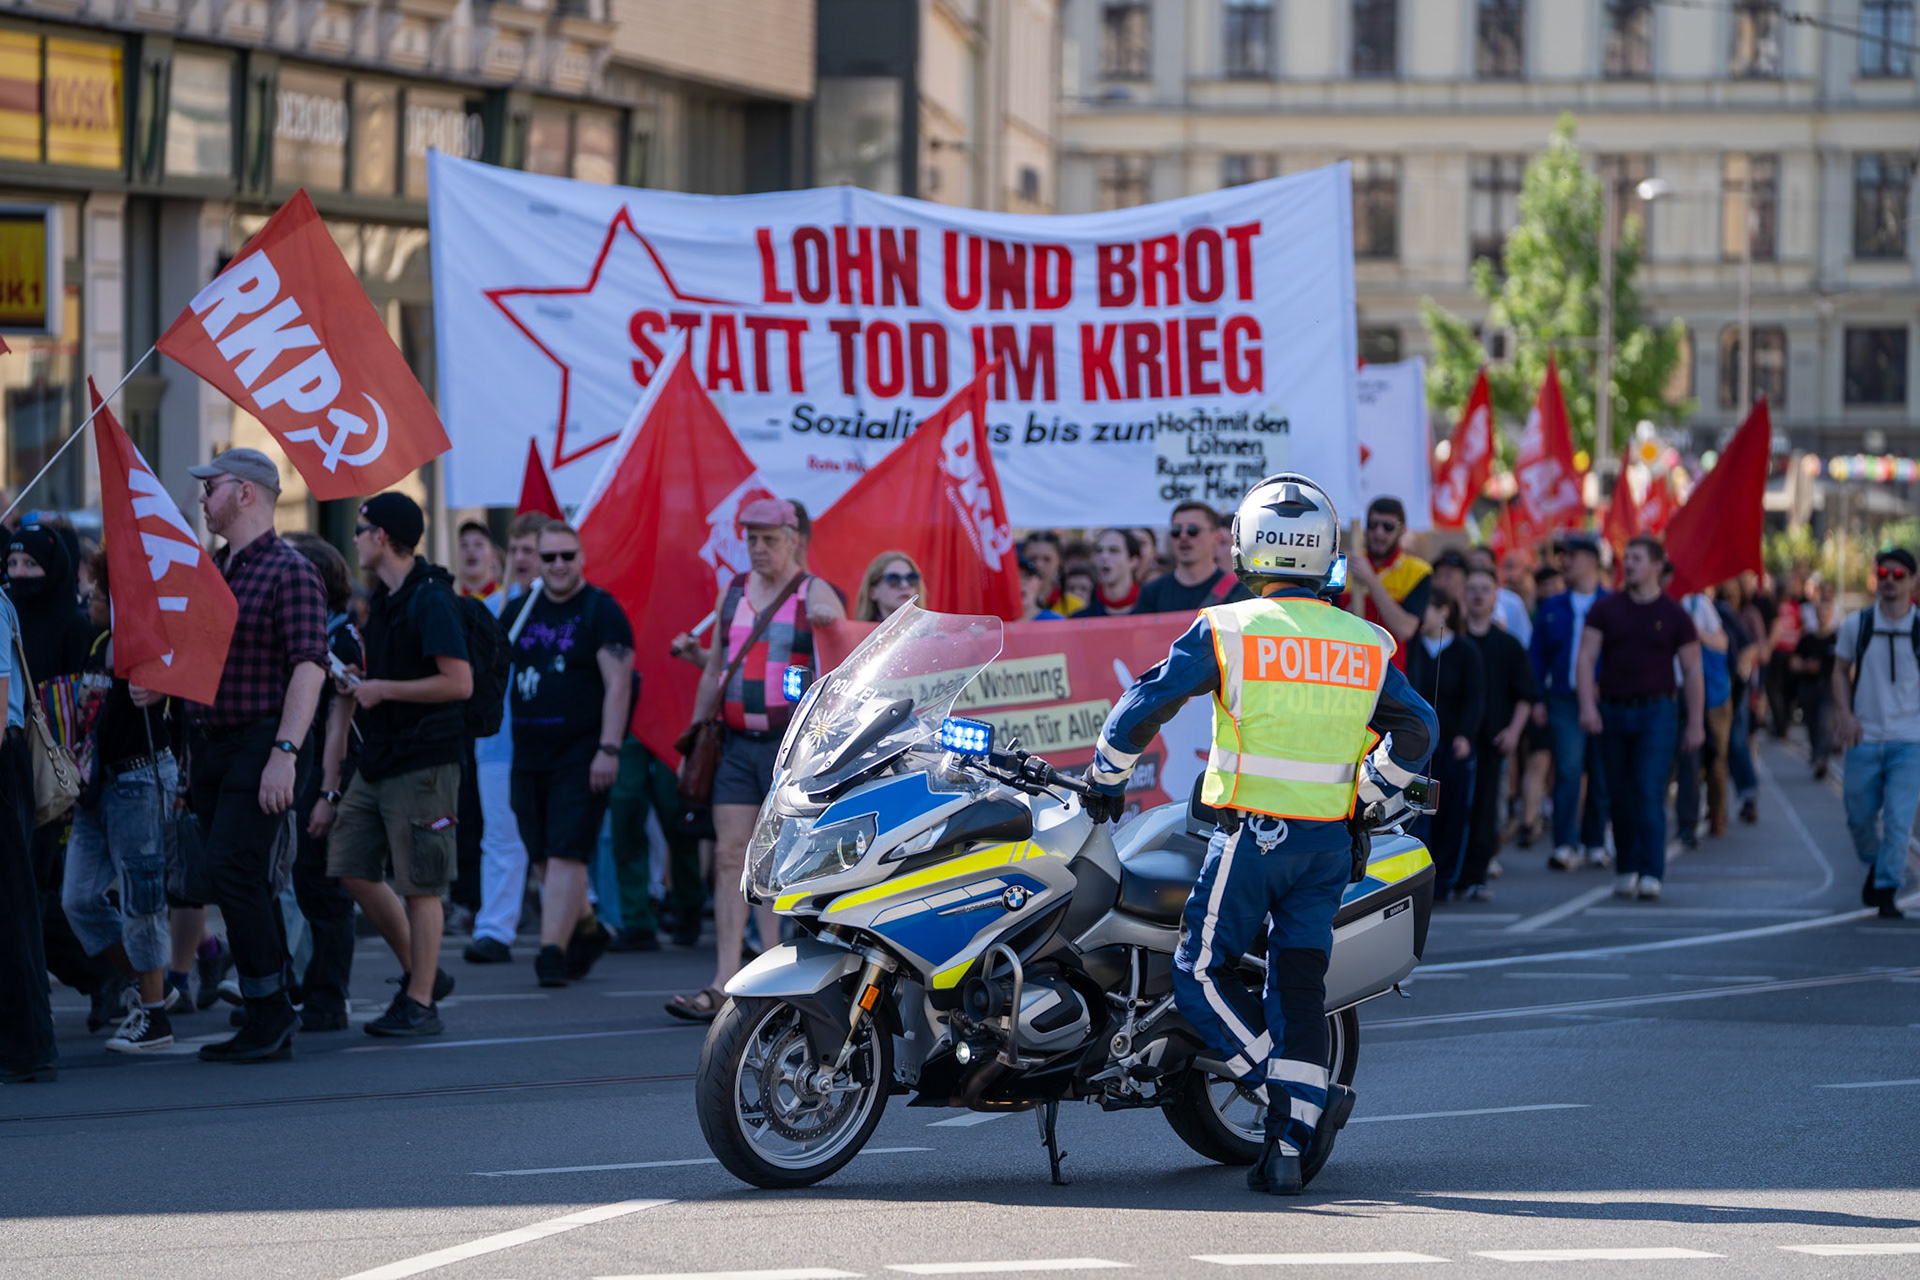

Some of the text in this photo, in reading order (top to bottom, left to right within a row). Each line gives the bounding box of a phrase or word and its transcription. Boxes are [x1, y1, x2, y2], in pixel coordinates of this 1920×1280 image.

[757, 221, 1262, 312] LOHN UND BROT
[189, 248, 342, 414] RKP
[629, 309, 1265, 402] STATT TOD IM KRIEG
[791, 405, 1011, 443] Sozialis
[1024, 410, 1078, 443] bis
[1157, 407, 1289, 434] Hoch mit den
[1156, 456, 1267, 478] Runter mit
[1160, 477, 1196, 501] der
[1256, 531, 1320, 548] POLIZEI
[1257, 637, 1370, 687] POLIZEI
[826, 678, 879, 703] POLZEI
[979, 667, 1065, 699] Wohnung
[1035, 714, 1062, 744] für
[1389, 903, 1405, 916] BMW
